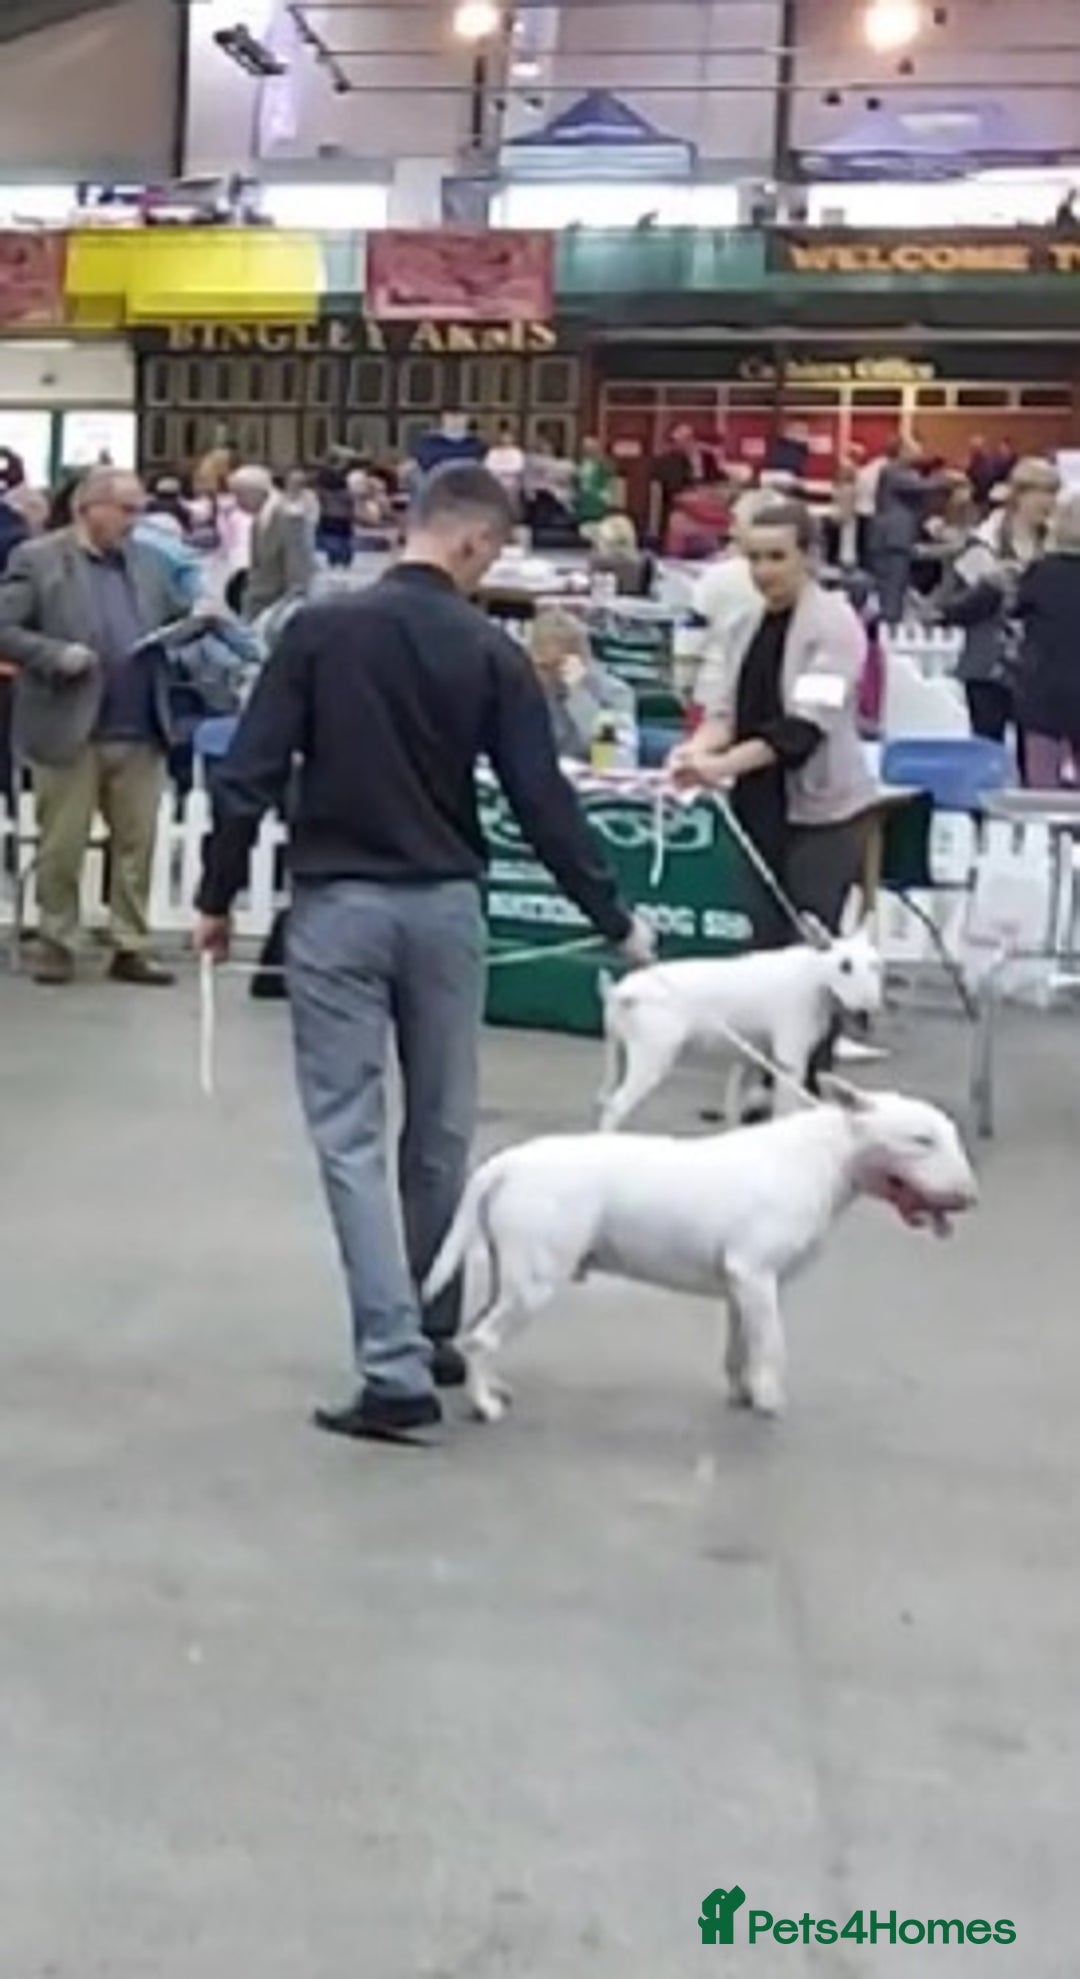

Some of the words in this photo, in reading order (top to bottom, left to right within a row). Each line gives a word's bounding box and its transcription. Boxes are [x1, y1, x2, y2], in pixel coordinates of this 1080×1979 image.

[790, 244, 1031, 271] WELCOME
[1049, 244, 1080, 271] T
[168, 320, 388, 350] BINGLEY
[411, 320, 557, 350] ARMS
